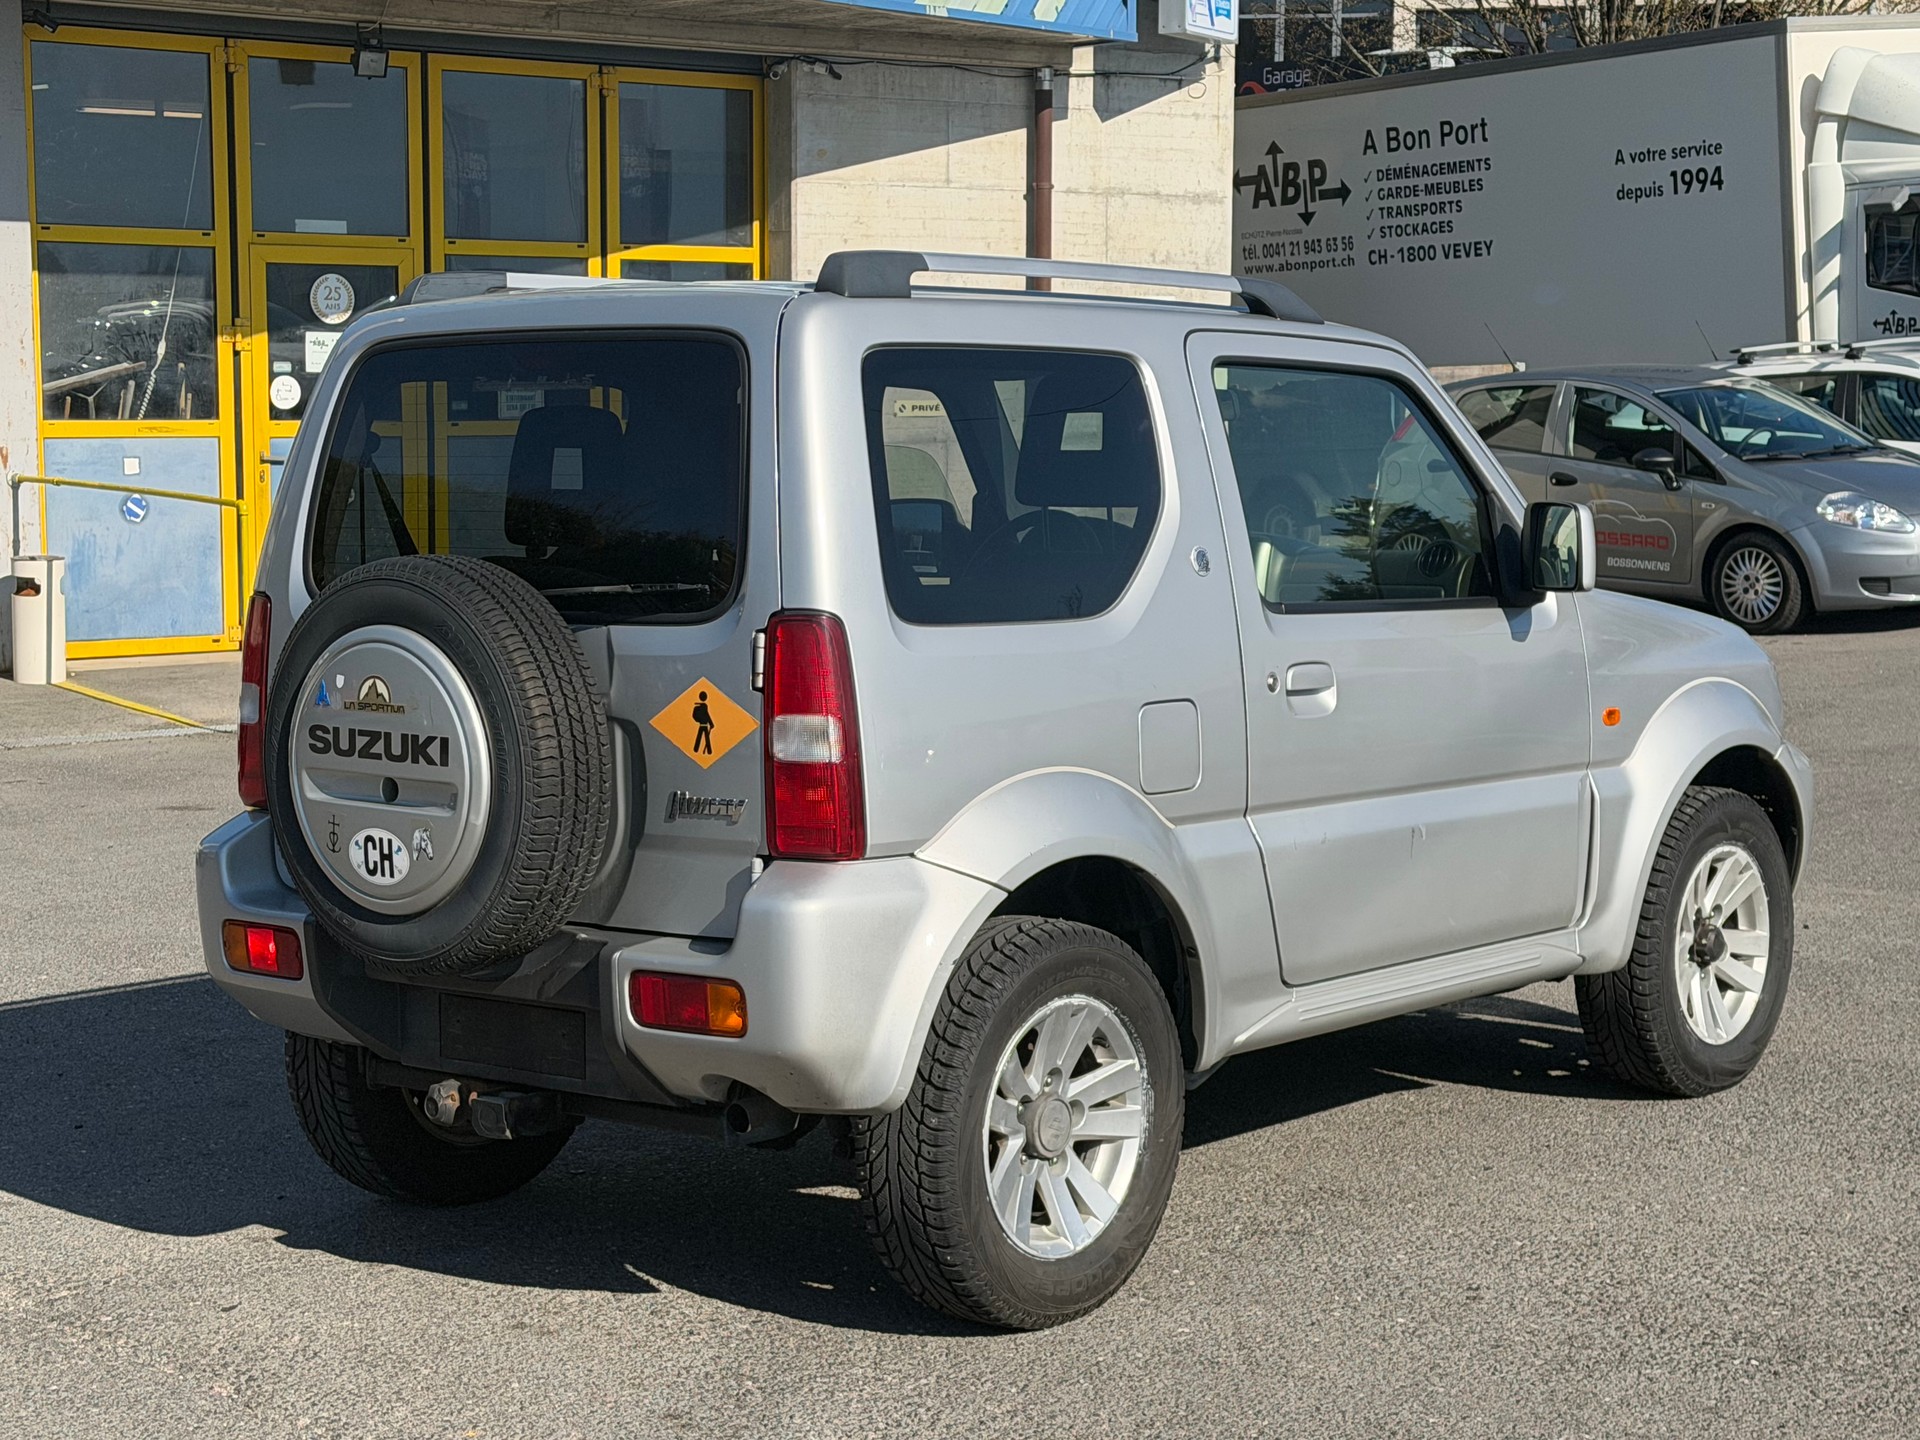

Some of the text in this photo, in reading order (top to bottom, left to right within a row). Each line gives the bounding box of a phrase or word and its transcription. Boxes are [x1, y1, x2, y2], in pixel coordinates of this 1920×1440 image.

[1263, 67, 1312, 87] Garage
[1362, 117, 1488, 155] A Bon Port
[1615, 139, 1723, 165] A votre service
[1376, 157, 1492, 182] DÉMÉNAGEMENTS
[1377, 178, 1484, 201] GARDE-MEUBLES
[1616, 166, 1724, 204] depuis 1994
[1378, 199, 1463, 219] TRANSPORTS
[1379, 220, 1454, 239] STOCKAGES
[1242, 235, 1354, 261] tél. 0041 21 943 63 56
[1441, 240, 1493, 260] VEVEY
[1244, 254, 1355, 275] www.abonport.ch
[324, 285, 342, 302] 25
[911, 402, 942, 412] PRIVÉ
[1607, 556, 1671, 572] BOSSONNENS
[343, 701, 356, 710] LA
[308, 724, 450, 768] SUZUKI
[363, 834, 395, 879] CH
